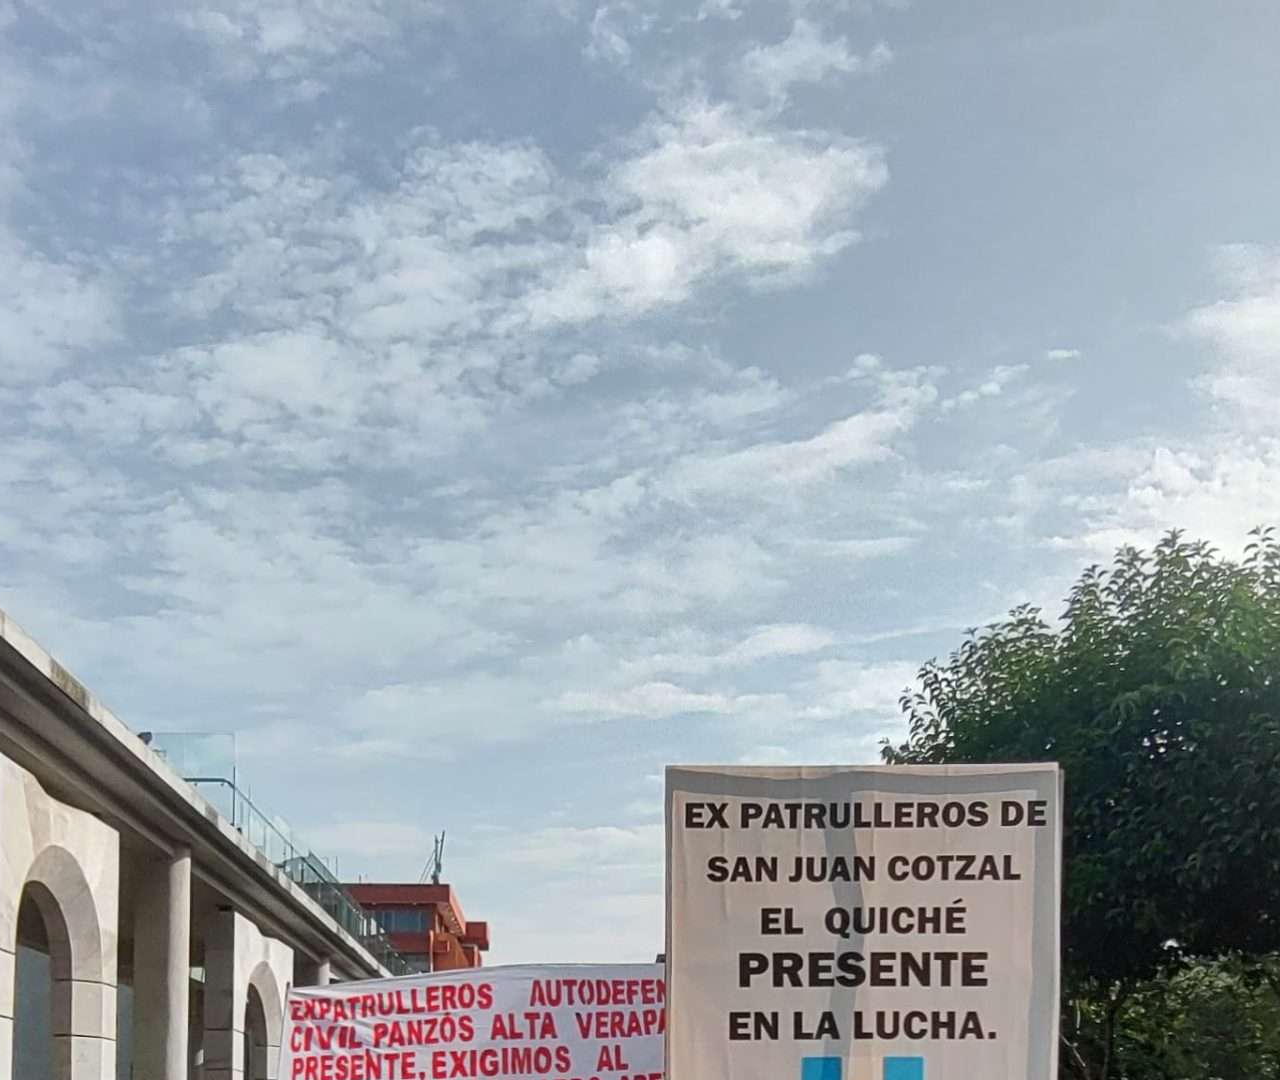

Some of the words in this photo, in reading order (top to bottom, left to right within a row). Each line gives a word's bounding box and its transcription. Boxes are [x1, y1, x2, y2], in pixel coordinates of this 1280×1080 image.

[685, 802, 729, 829] EX
[740, 801, 989, 829] PATRULLEROS
[1001, 800, 1047, 827] DE
[707, 856, 778, 882] SAN
[789, 856, 875, 882] JUAN
[887, 855, 1021, 881] COTZAL
[760, 907, 804, 935] EL
[825, 898, 967, 938] QUICHÉ
[738, 951, 989, 988] PRESENTE
[289, 983, 494, 1021] EXPATRULLEROS
[290, 1024, 363, 1052] CIVIL
[490, 1012, 558, 1042] ALTA
[728, 1011, 779, 1041] EN
[794, 1011, 840, 1041] LA
[854, 1010, 997, 1040] LUCHA.
[596, 1044, 629, 1072] AL
